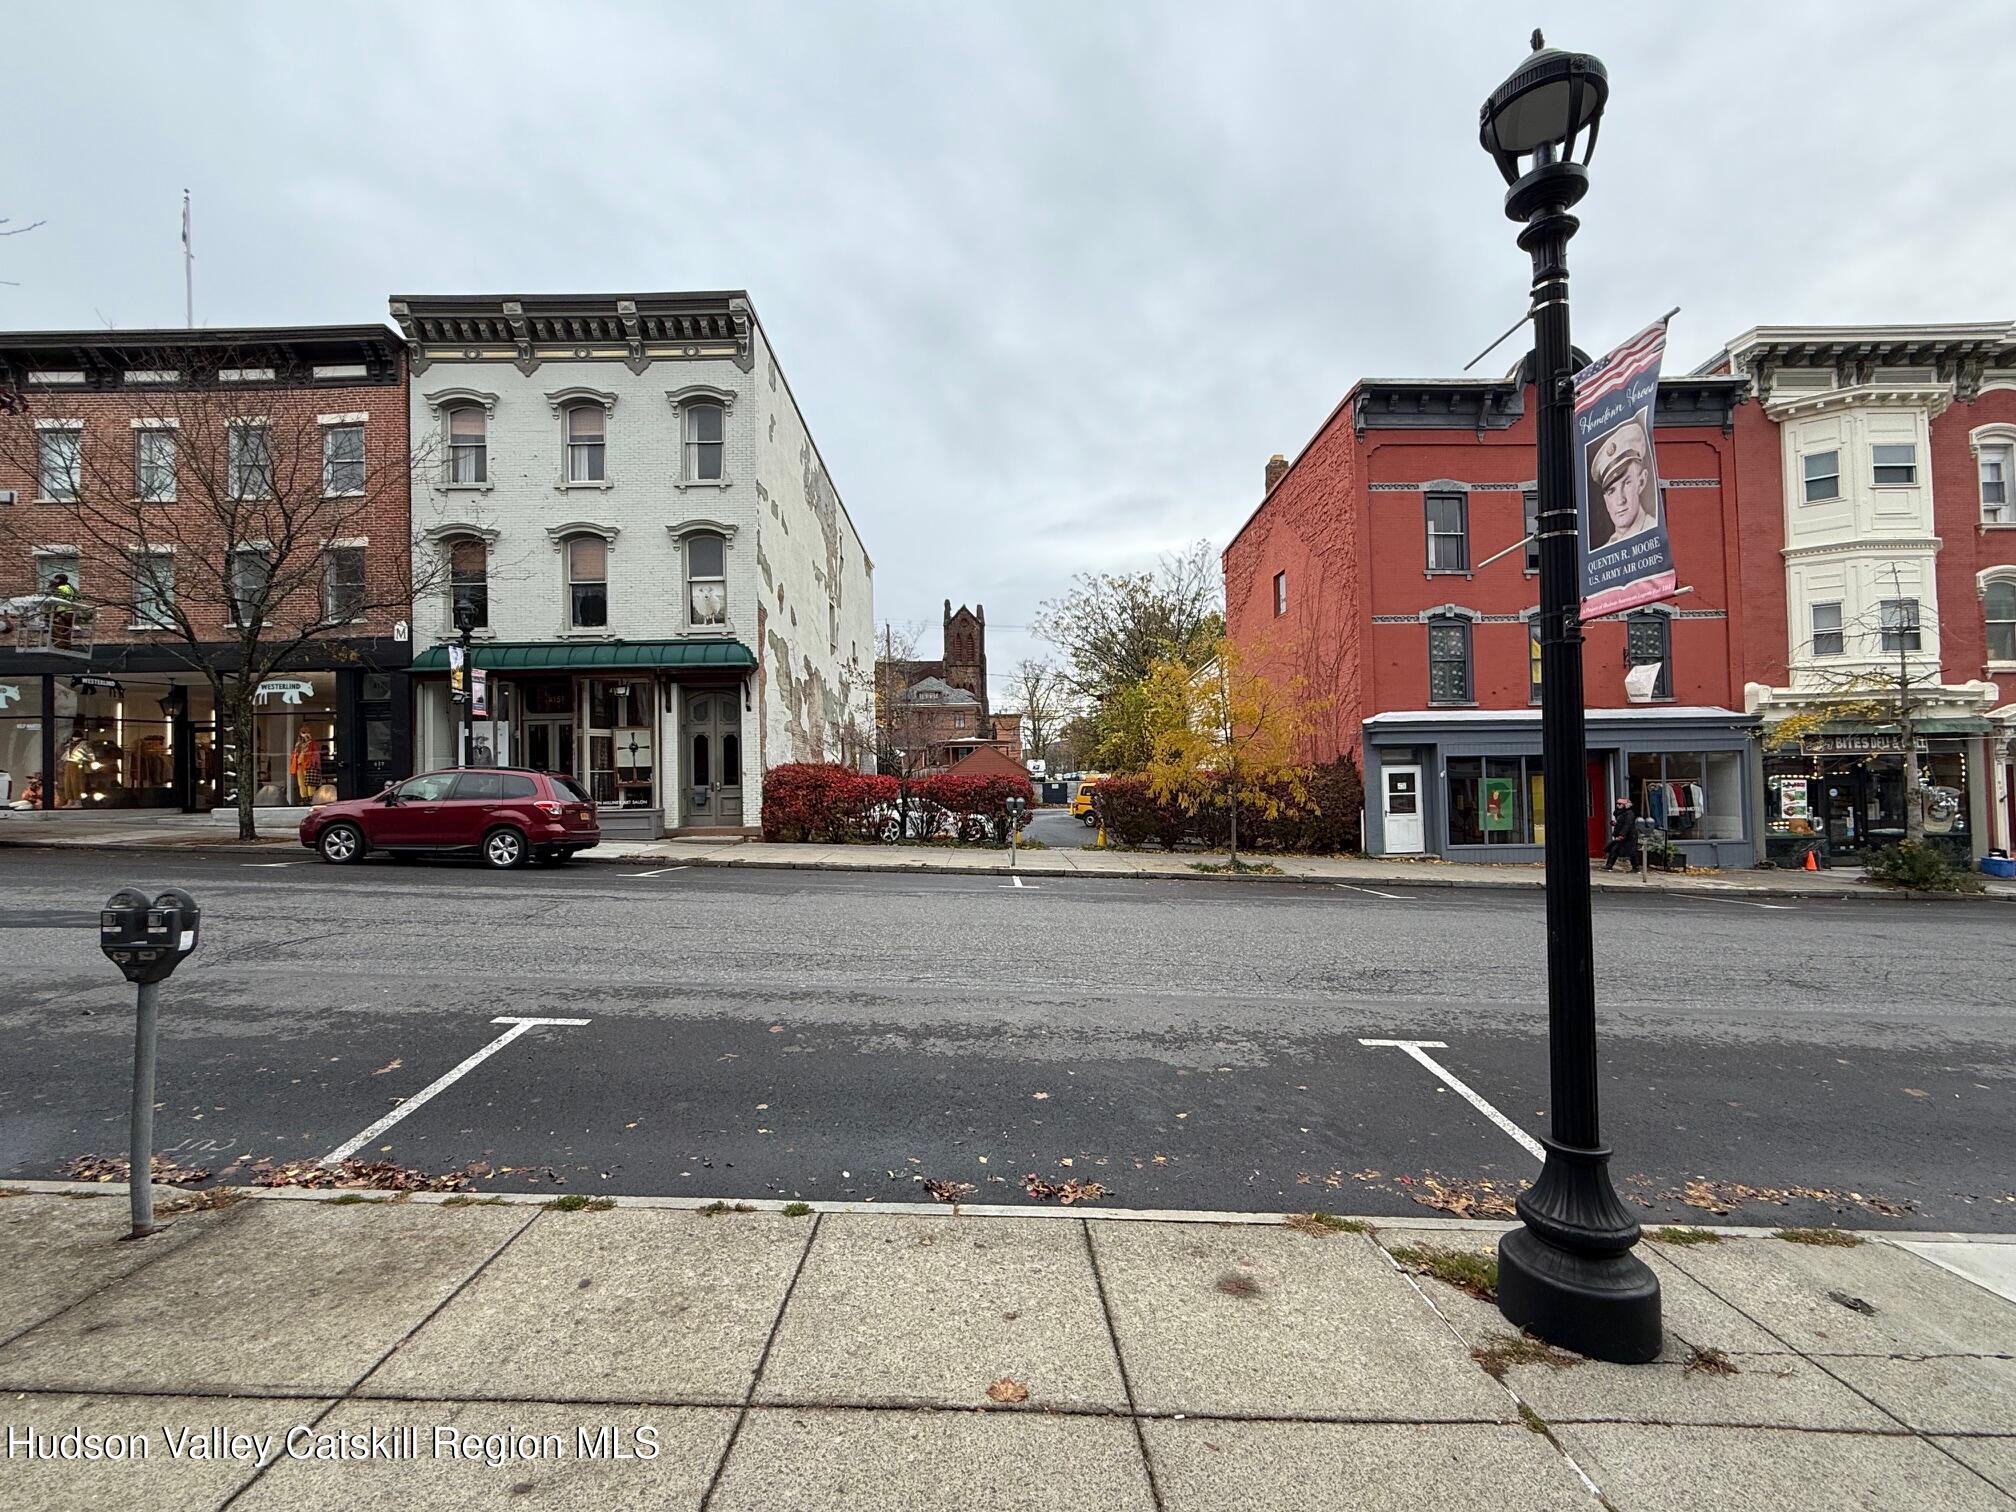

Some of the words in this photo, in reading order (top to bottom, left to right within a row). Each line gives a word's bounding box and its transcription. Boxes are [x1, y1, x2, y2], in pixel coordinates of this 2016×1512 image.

[1579, 403, 1625, 435] Hometown
[1626, 380, 1655, 408] Heroes
[1587, 551, 1620, 575] QUENTIN
[1621, 549, 1630, 561] R.
[1631, 536, 1661, 557] MOORE
[1588, 574, 1600, 586] U.S.
[1601, 566, 1622, 582] ARMY
[1622, 562, 1637, 575] AIR
[1637, 552, 1664, 570] CORPS
[396, 628, 406, 639] M
[82, 677, 116, 687] WESTERLIND
[1835, 736, 1870, 749] BITES
[1870, 736, 1890, 749] DELI
